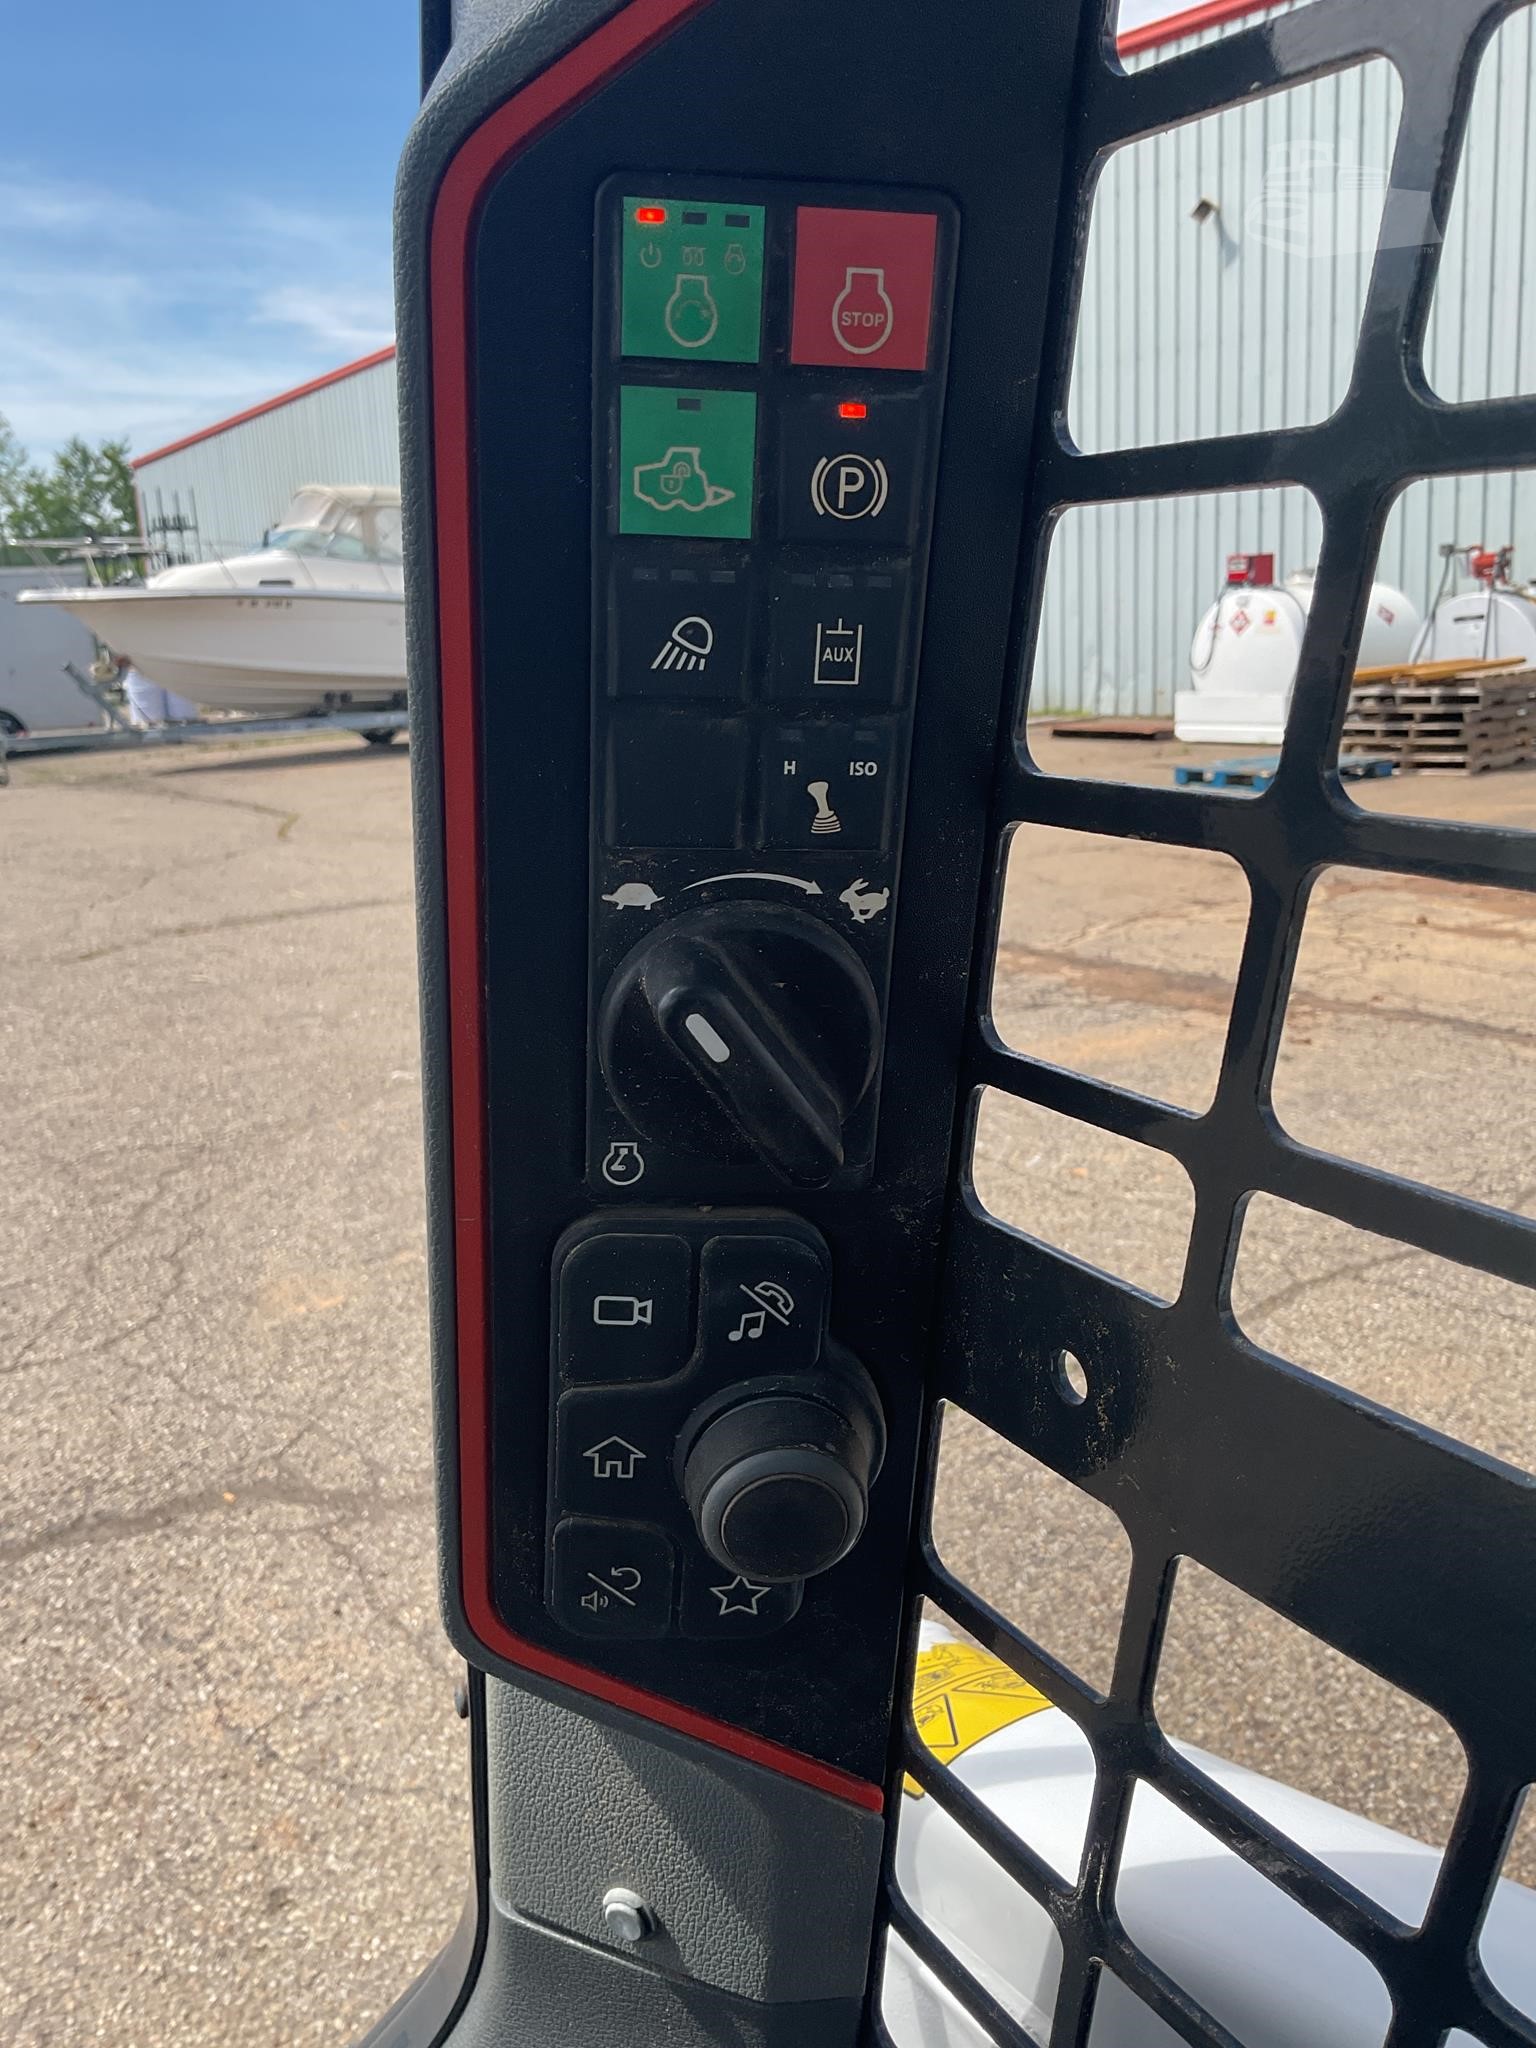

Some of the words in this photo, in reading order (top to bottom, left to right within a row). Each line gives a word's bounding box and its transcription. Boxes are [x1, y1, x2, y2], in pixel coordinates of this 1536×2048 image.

[841, 311, 885, 327] STOP
[838, 466, 865, 509] P
[822, 647, 855, 662] AUX
[783, 760, 796, 775] H
[849, 761, 878, 776] ISO
